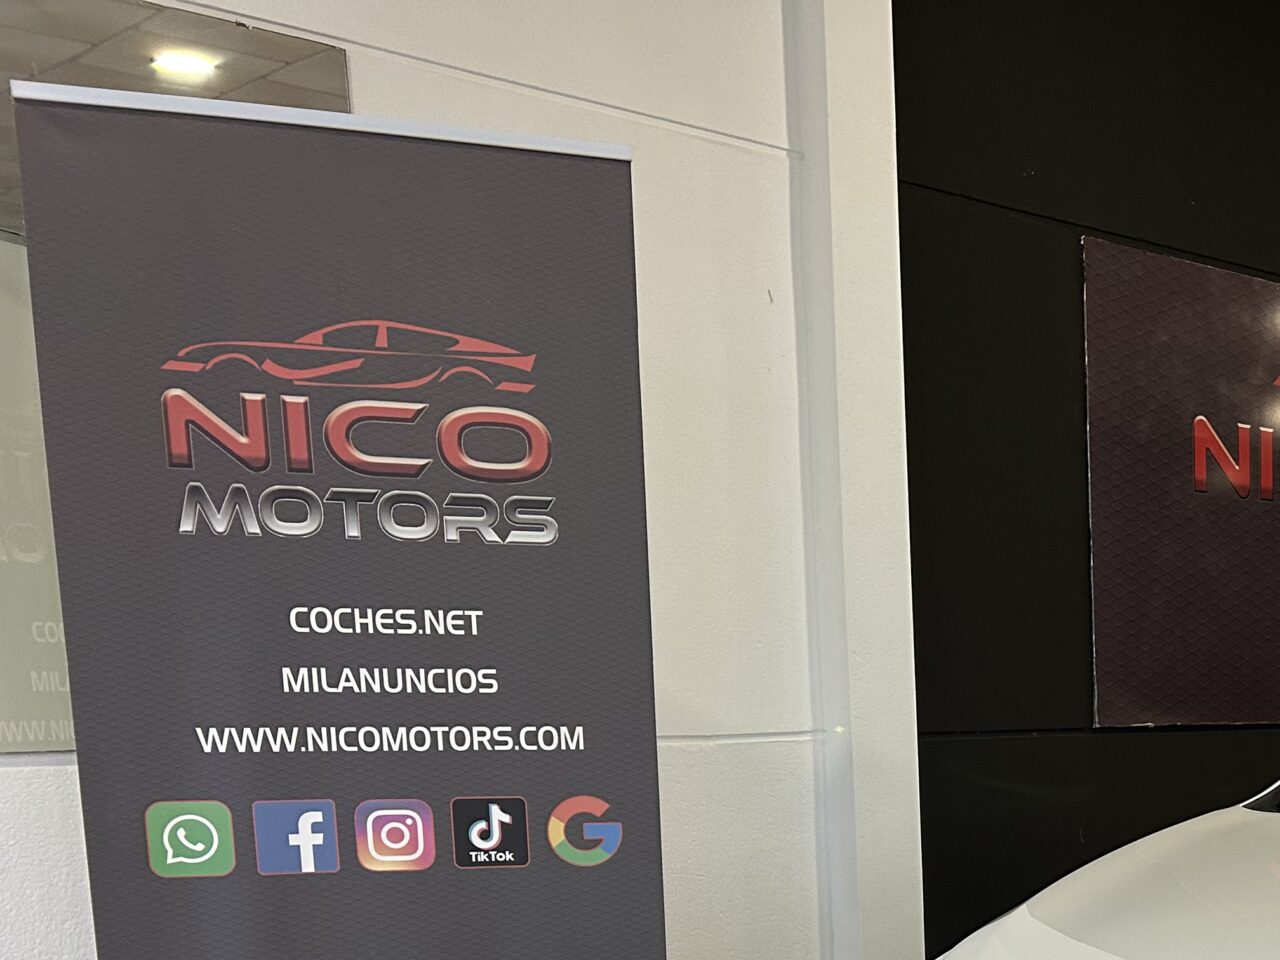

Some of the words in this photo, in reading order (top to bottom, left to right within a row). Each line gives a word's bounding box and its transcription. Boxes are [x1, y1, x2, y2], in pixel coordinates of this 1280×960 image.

[161, 388, 552, 483] NICO
[178, 482, 560, 547] MOTORS
[289, 606, 484, 637] COCHES.NET
[281, 666, 499, 695] MILANUNCIOS
[195, 725, 586, 753] WWW.NICOMOTORS.COM
[469, 850, 515, 863] TikTok
